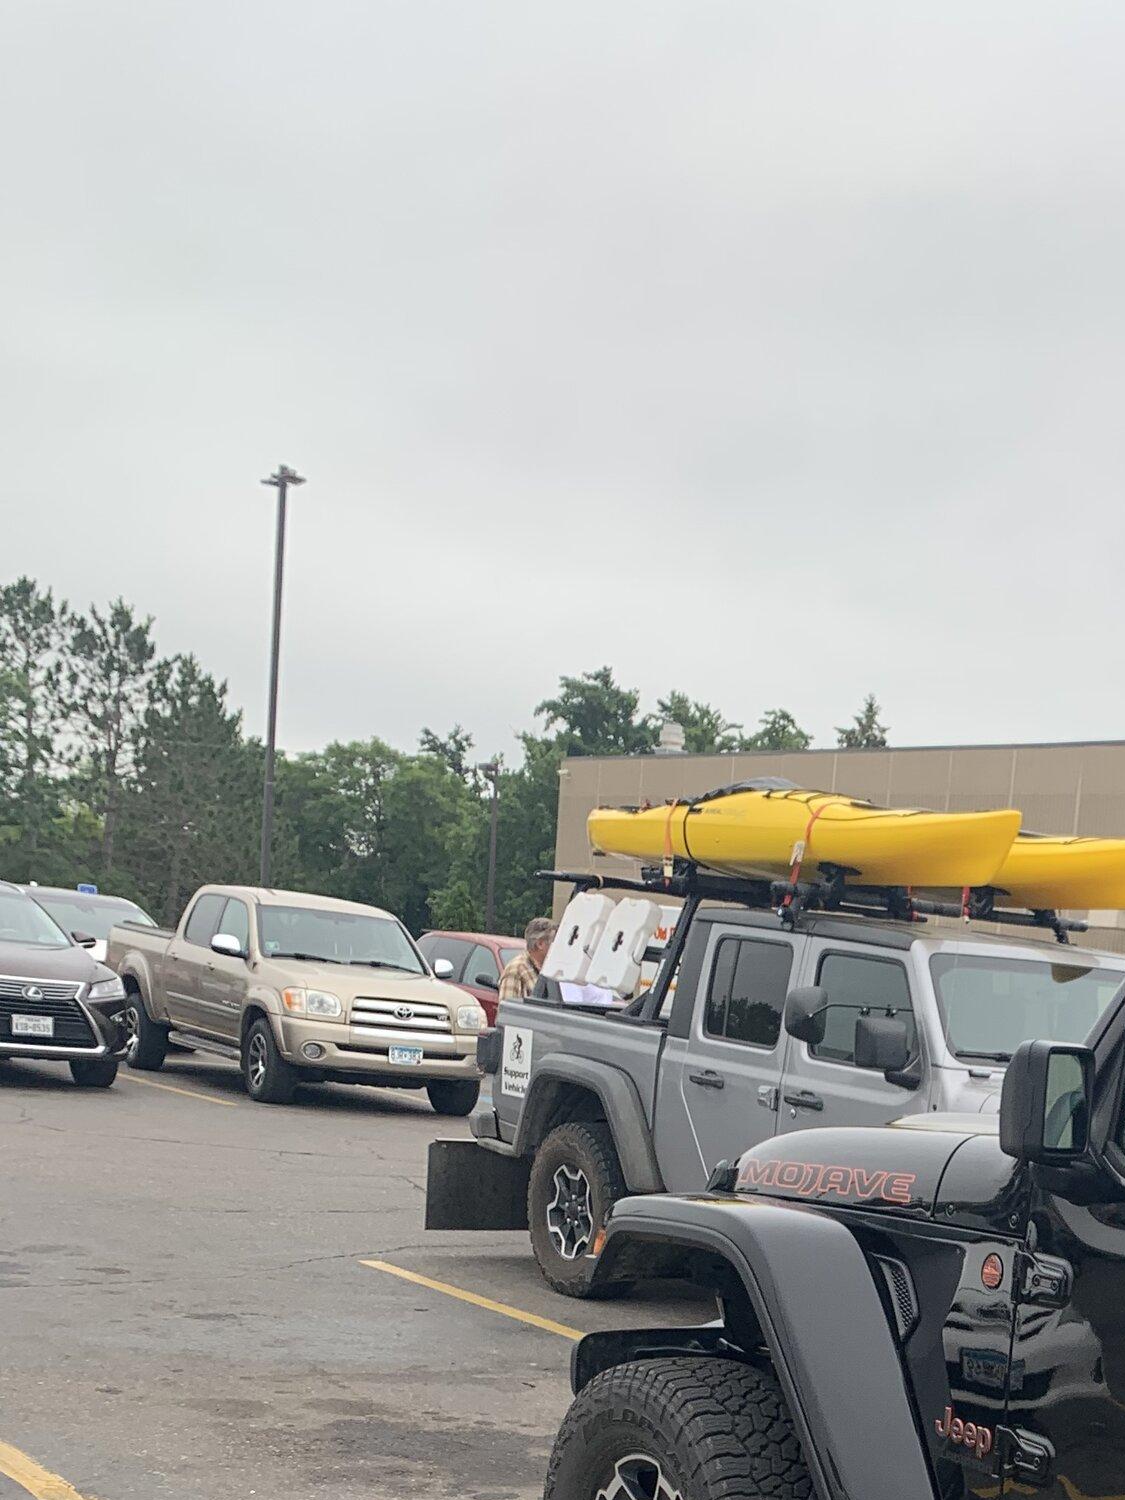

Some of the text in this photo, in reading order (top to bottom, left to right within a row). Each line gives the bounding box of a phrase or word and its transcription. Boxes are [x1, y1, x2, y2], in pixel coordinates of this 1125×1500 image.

[503, 1066, 530, 1080] Support
[739, 1159, 916, 1203] MOJAVE
[935, 1406, 992, 1459] Jeep
